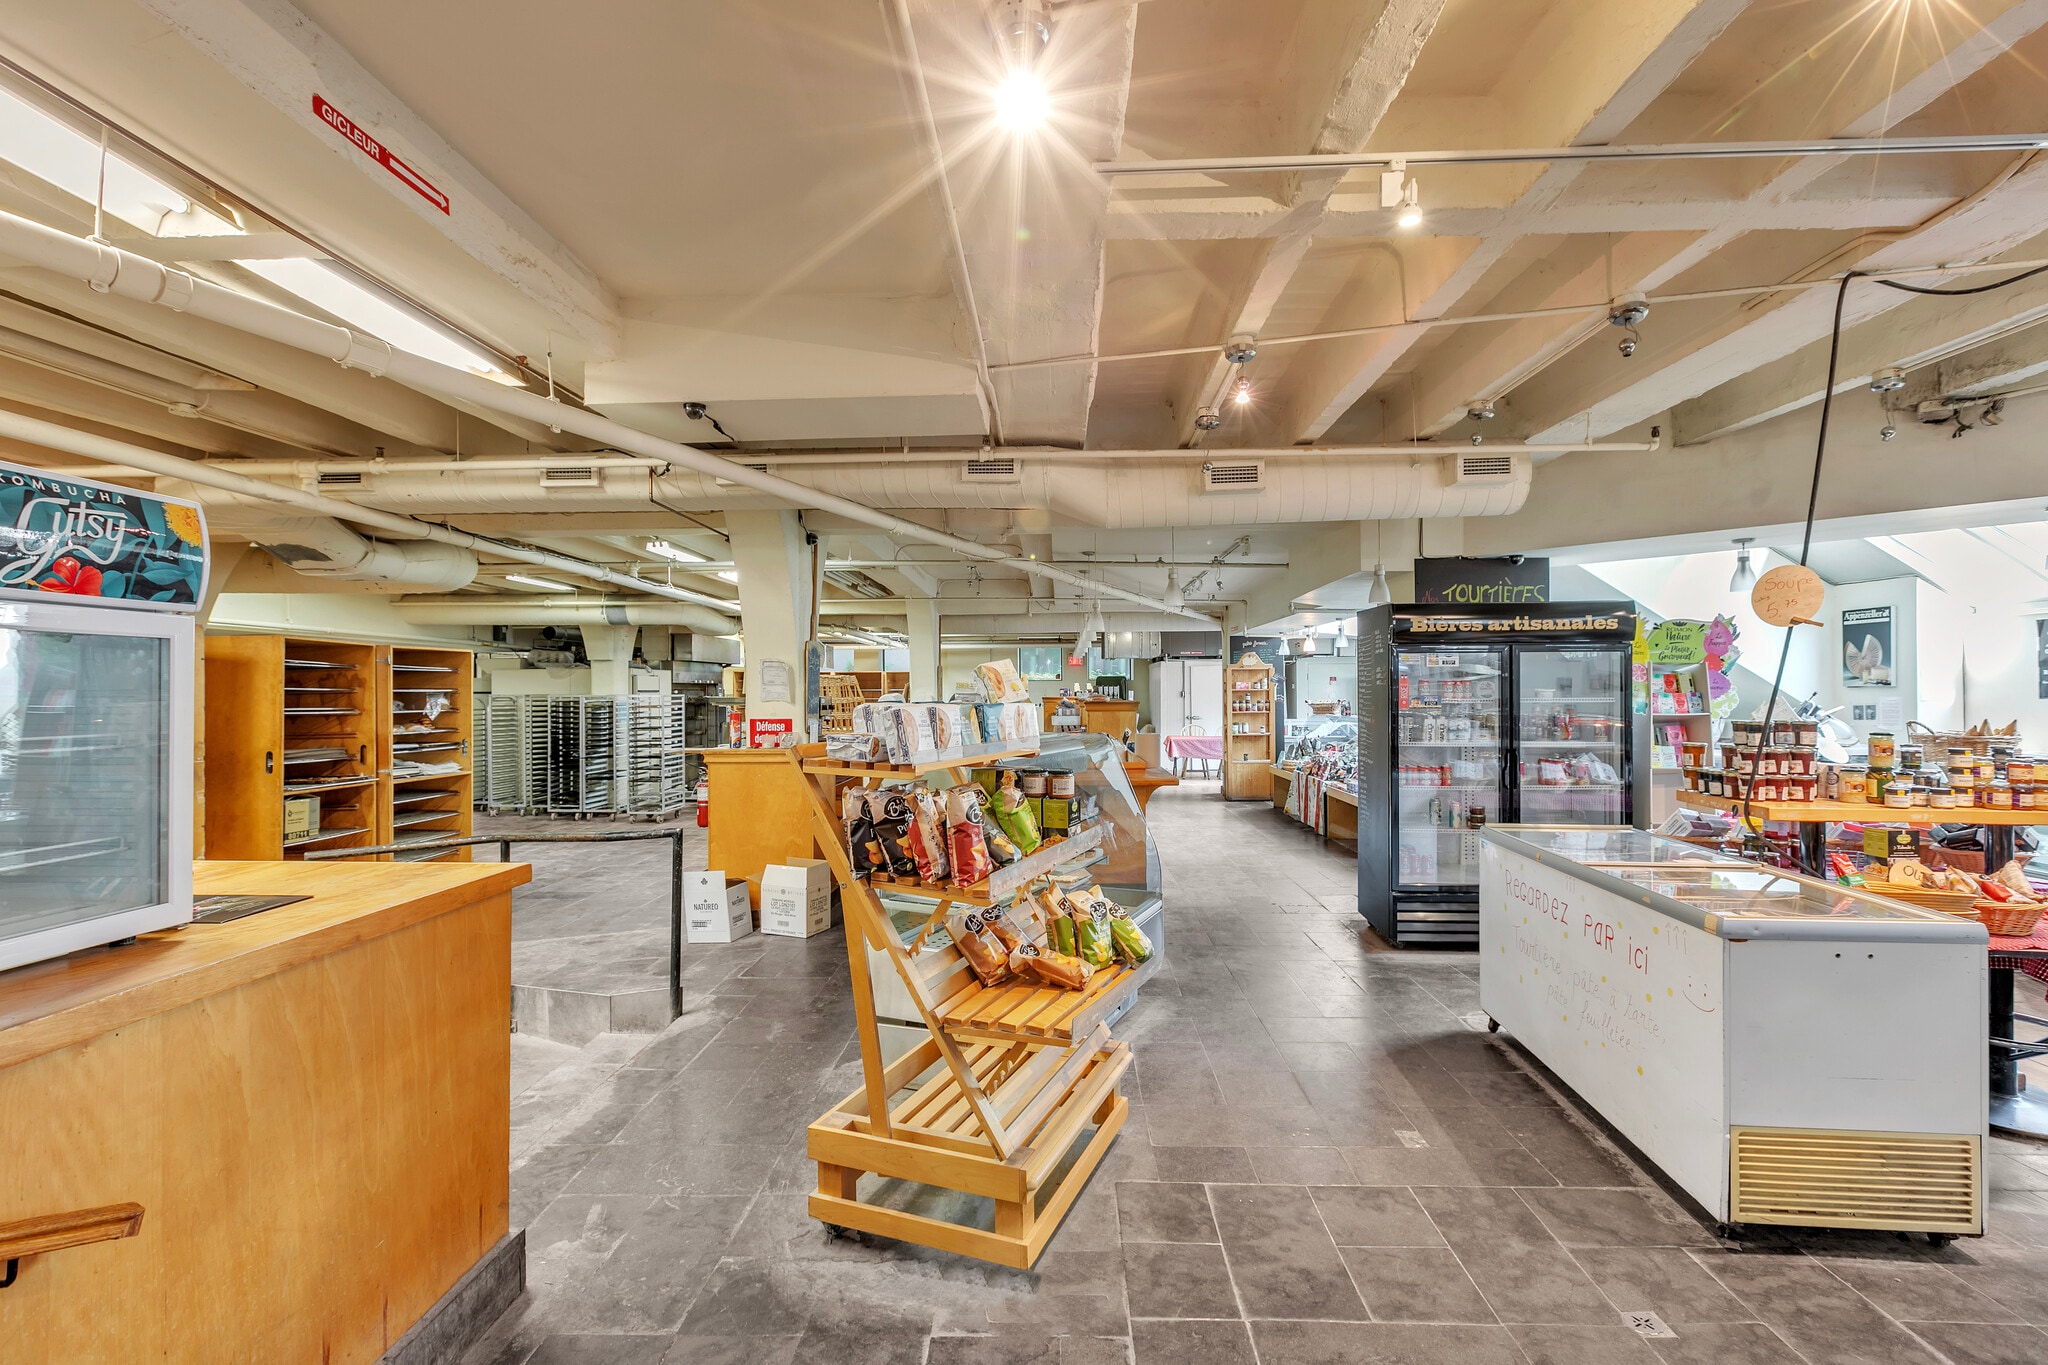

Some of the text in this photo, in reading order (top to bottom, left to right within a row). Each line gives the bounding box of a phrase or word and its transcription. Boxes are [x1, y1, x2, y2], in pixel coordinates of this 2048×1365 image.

[321, 104, 380, 159] GICLEUR
[0, 497, 128, 584] Gutsy
[1409, 614, 1619, 633] Bières artisanales
[756, 720, 785, 732] Défense
[693, 903, 719, 911] NATUREO
[1628, 936, 1649, 975] ici
